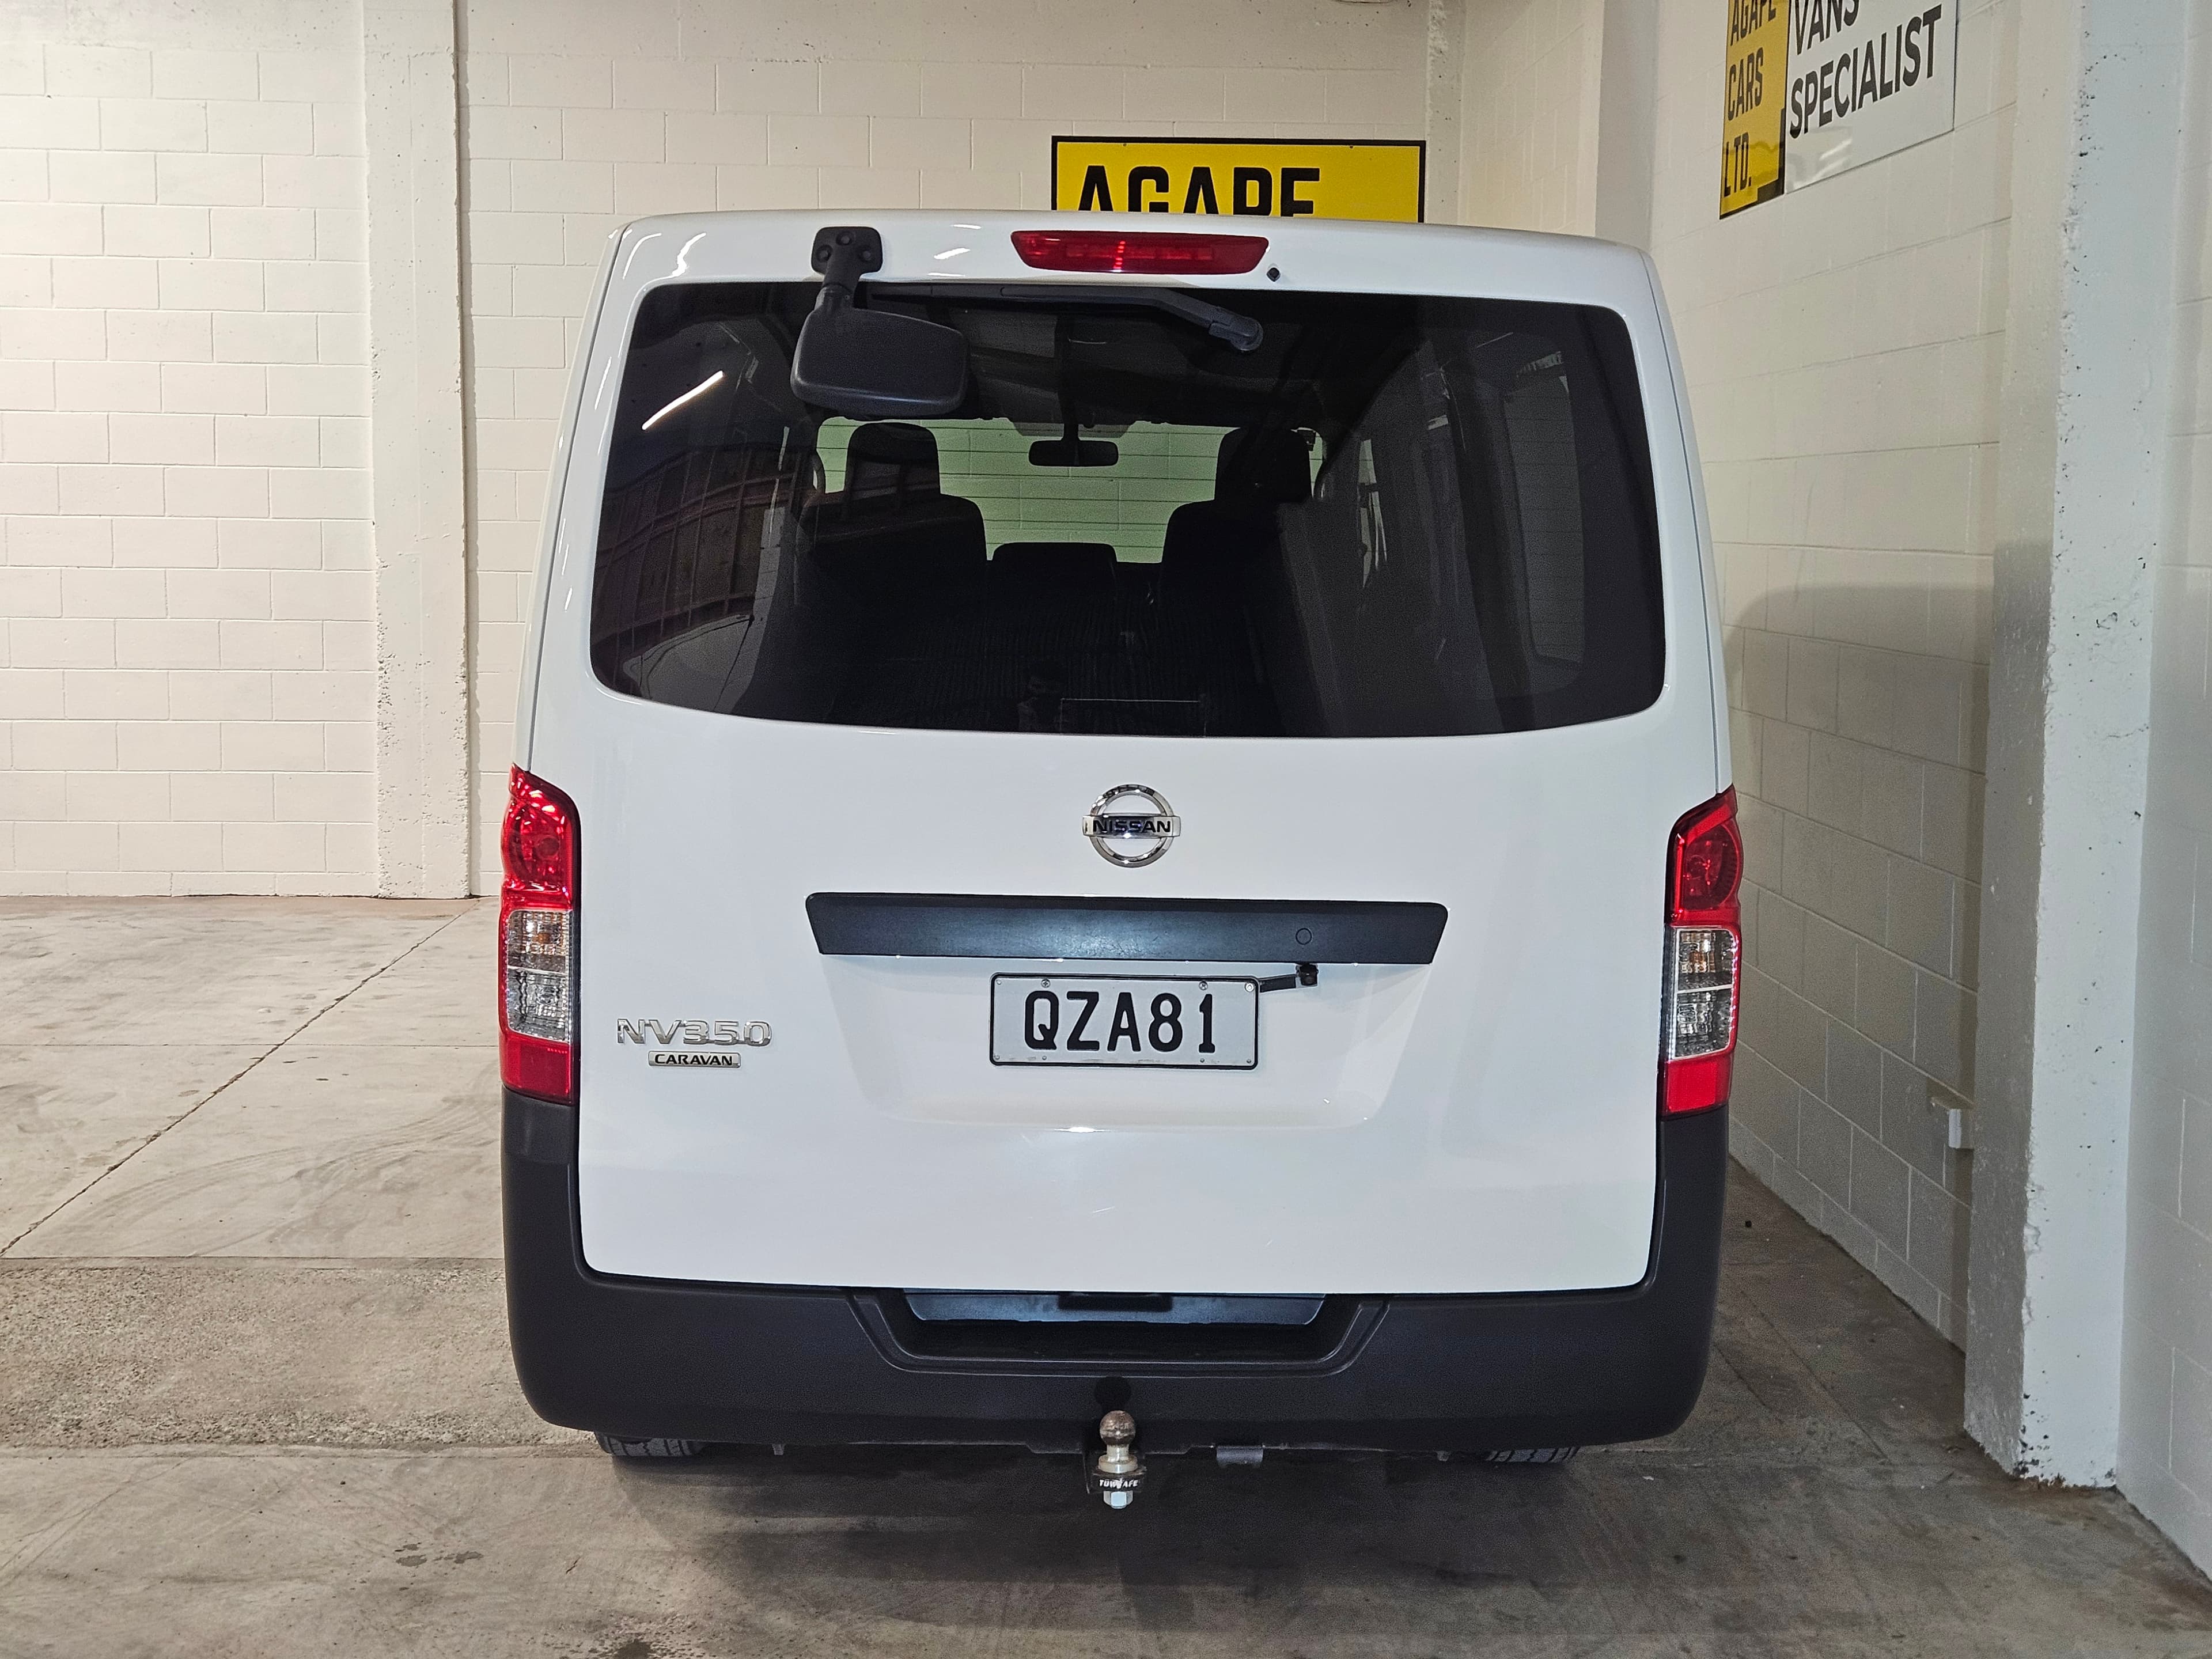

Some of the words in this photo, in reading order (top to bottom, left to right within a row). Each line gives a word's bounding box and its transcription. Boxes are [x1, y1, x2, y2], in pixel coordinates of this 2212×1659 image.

[1728, 47, 1763, 120] CARS
[1790, 4, 1941, 139] SPECIALIST
[1724, 132, 1751, 197] LTD.
[1093, 819, 1171, 833] NISSAN
[617, 1018, 772, 1046] NV350
[1024, 990, 1215, 1054] QZA81
[654, 1054, 733, 1066] CARAVAN
